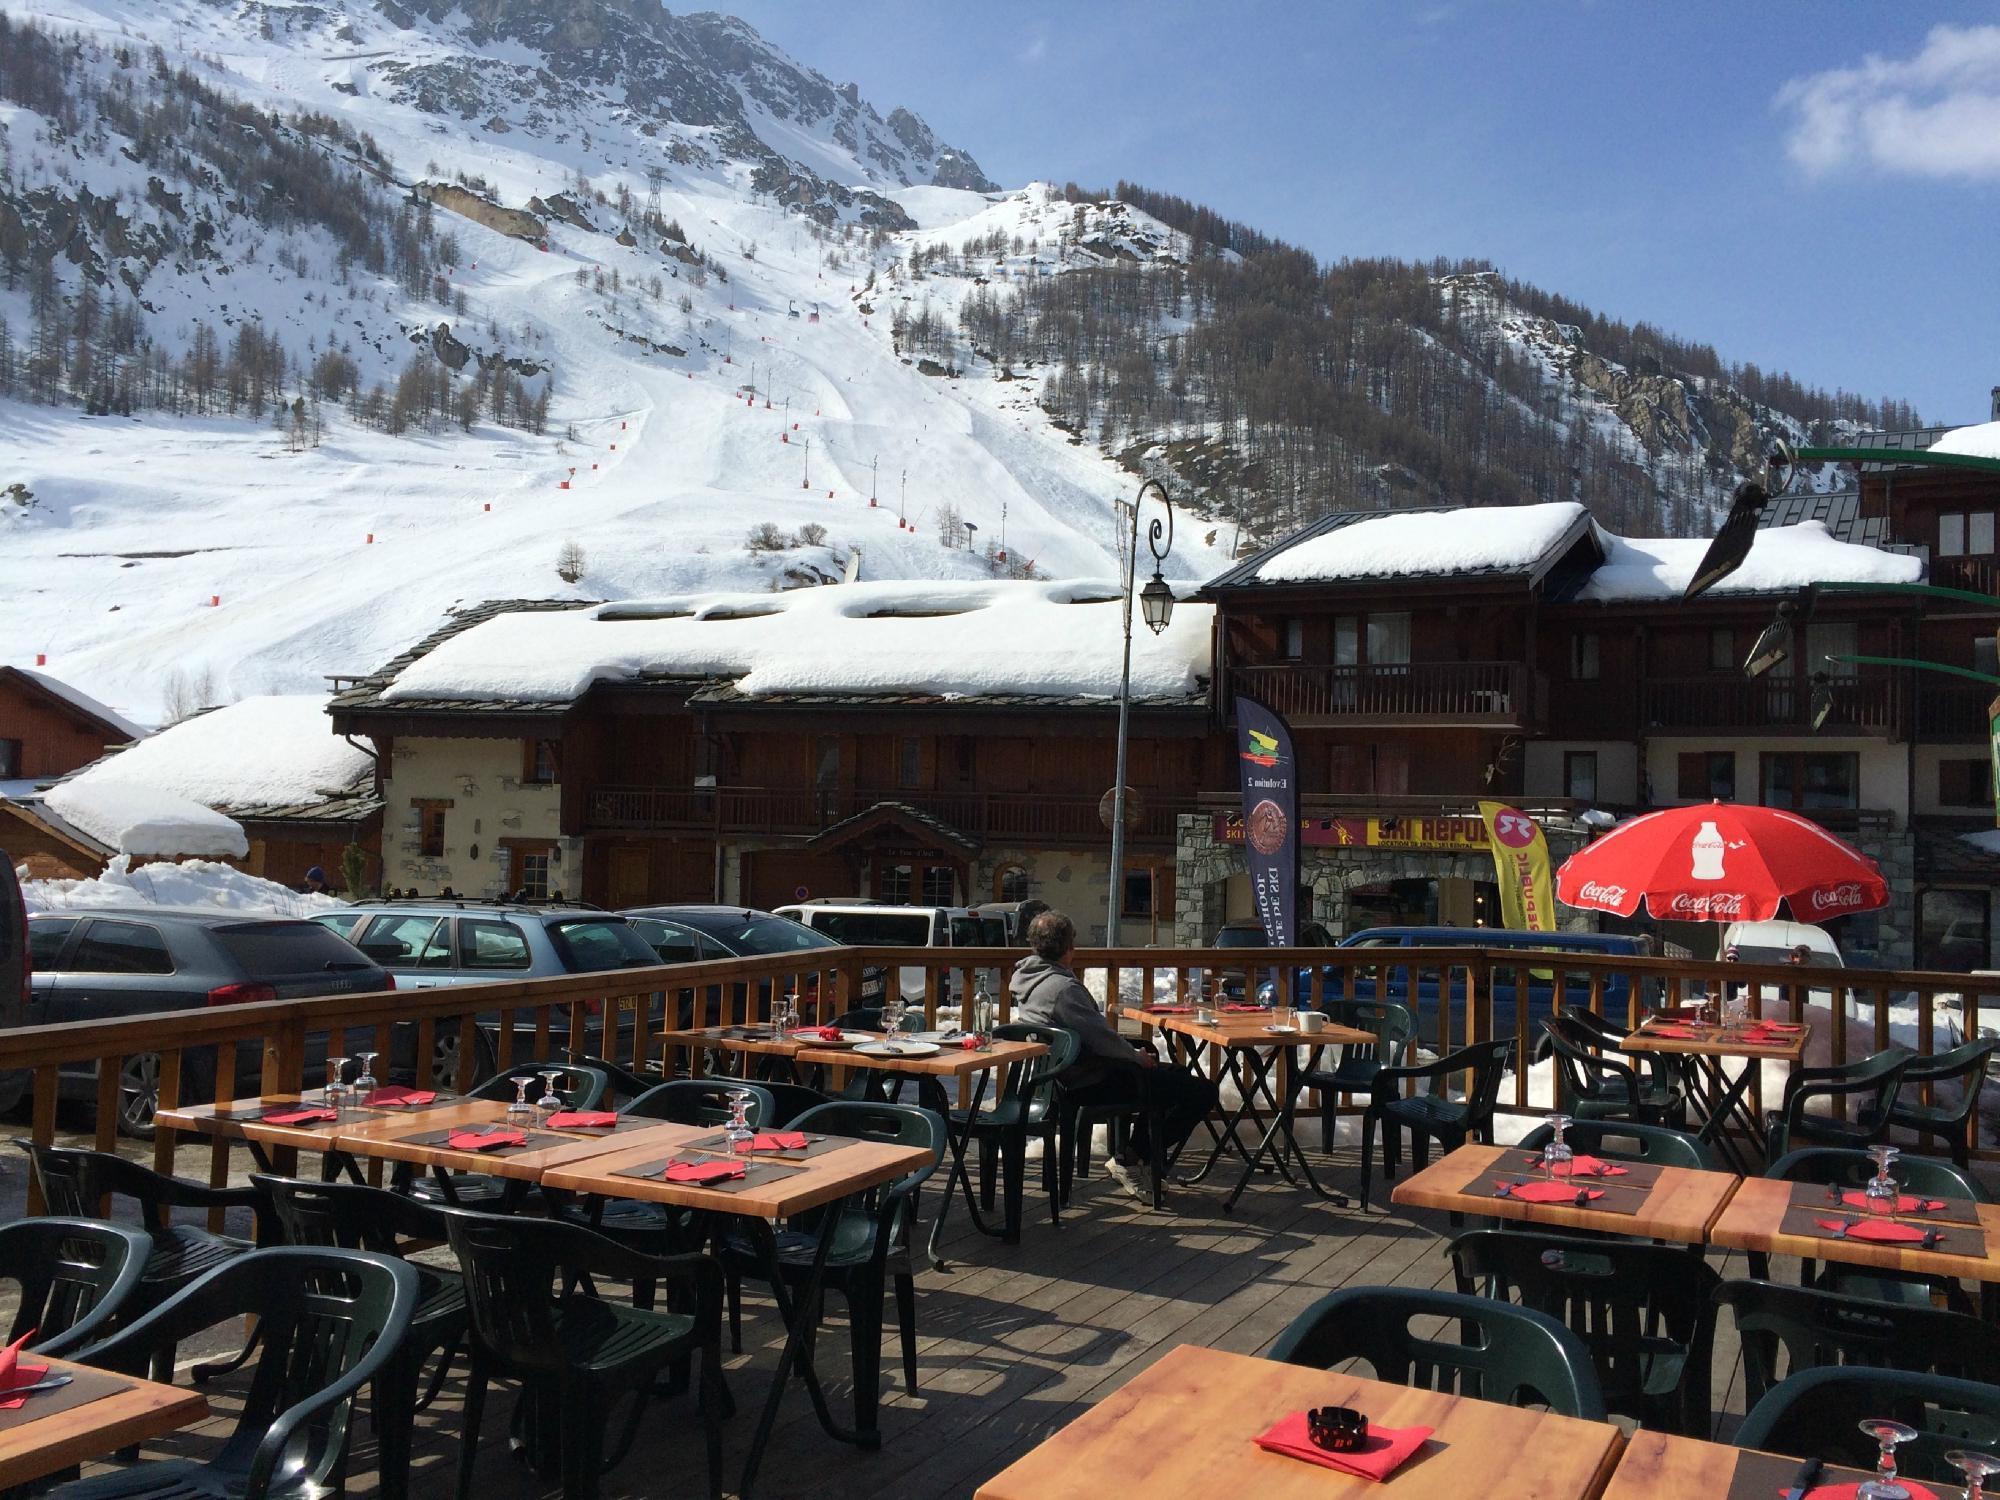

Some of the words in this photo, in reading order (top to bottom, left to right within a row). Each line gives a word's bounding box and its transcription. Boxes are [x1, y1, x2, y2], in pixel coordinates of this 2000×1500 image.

[1580, 880, 1628, 906] Coca-Cola
[1671, 893, 1747, 914] Coca-Cola
[1812, 884, 1864, 910] Coca-Cola
